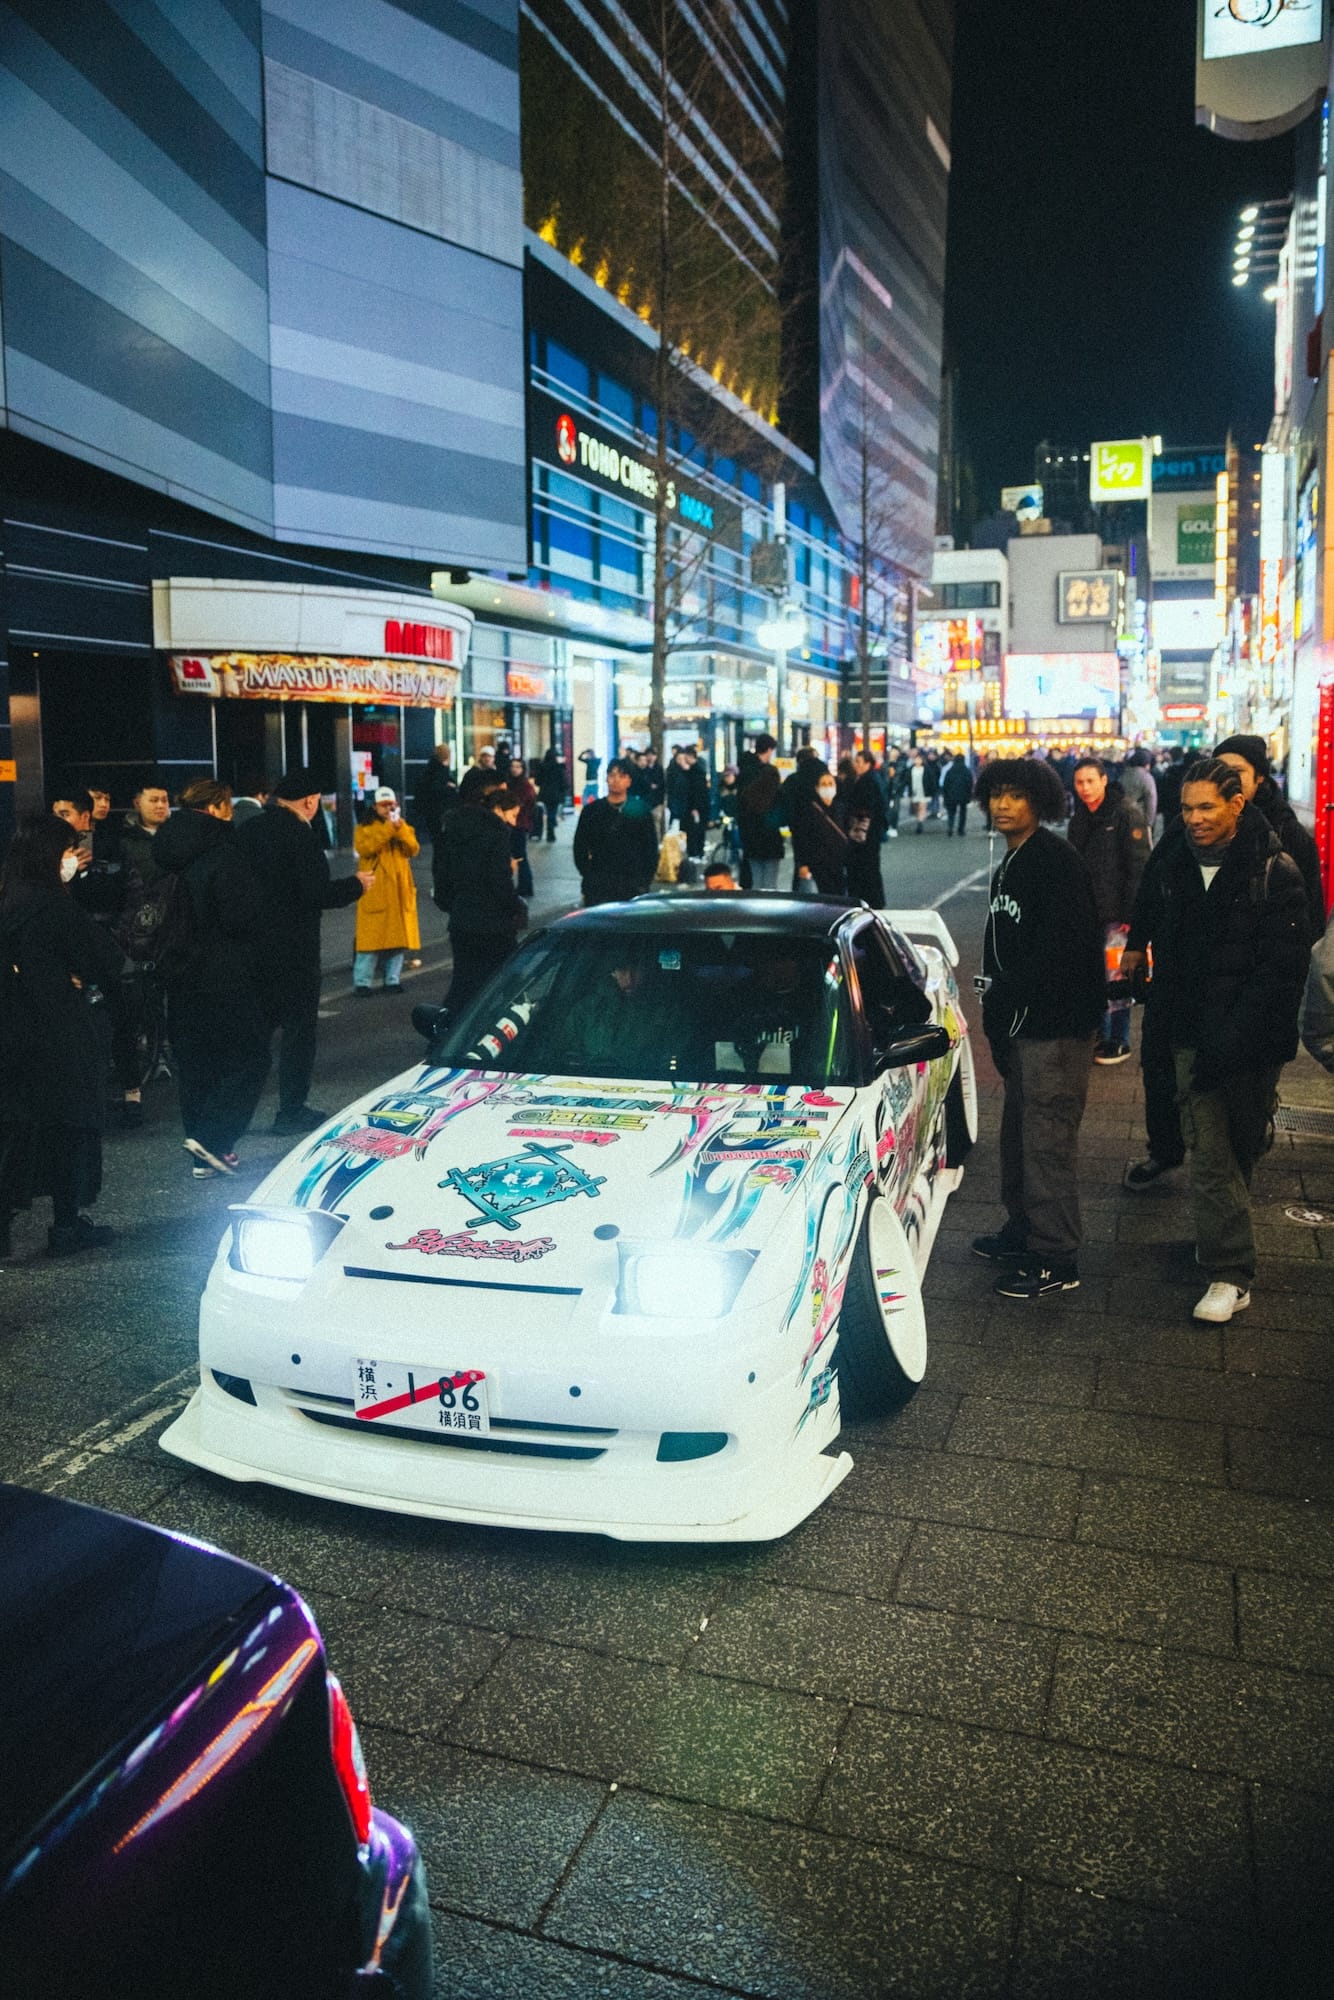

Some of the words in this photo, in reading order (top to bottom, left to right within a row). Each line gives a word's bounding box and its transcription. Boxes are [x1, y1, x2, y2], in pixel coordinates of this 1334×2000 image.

[578, 432, 620, 482] TOHO
[620, 455, 677, 510] CINES
[1181, 519, 1216, 534] GOL
[358, 1366, 378, 1401] 横浜
[439, 1410, 482, 1431] 横須賀
